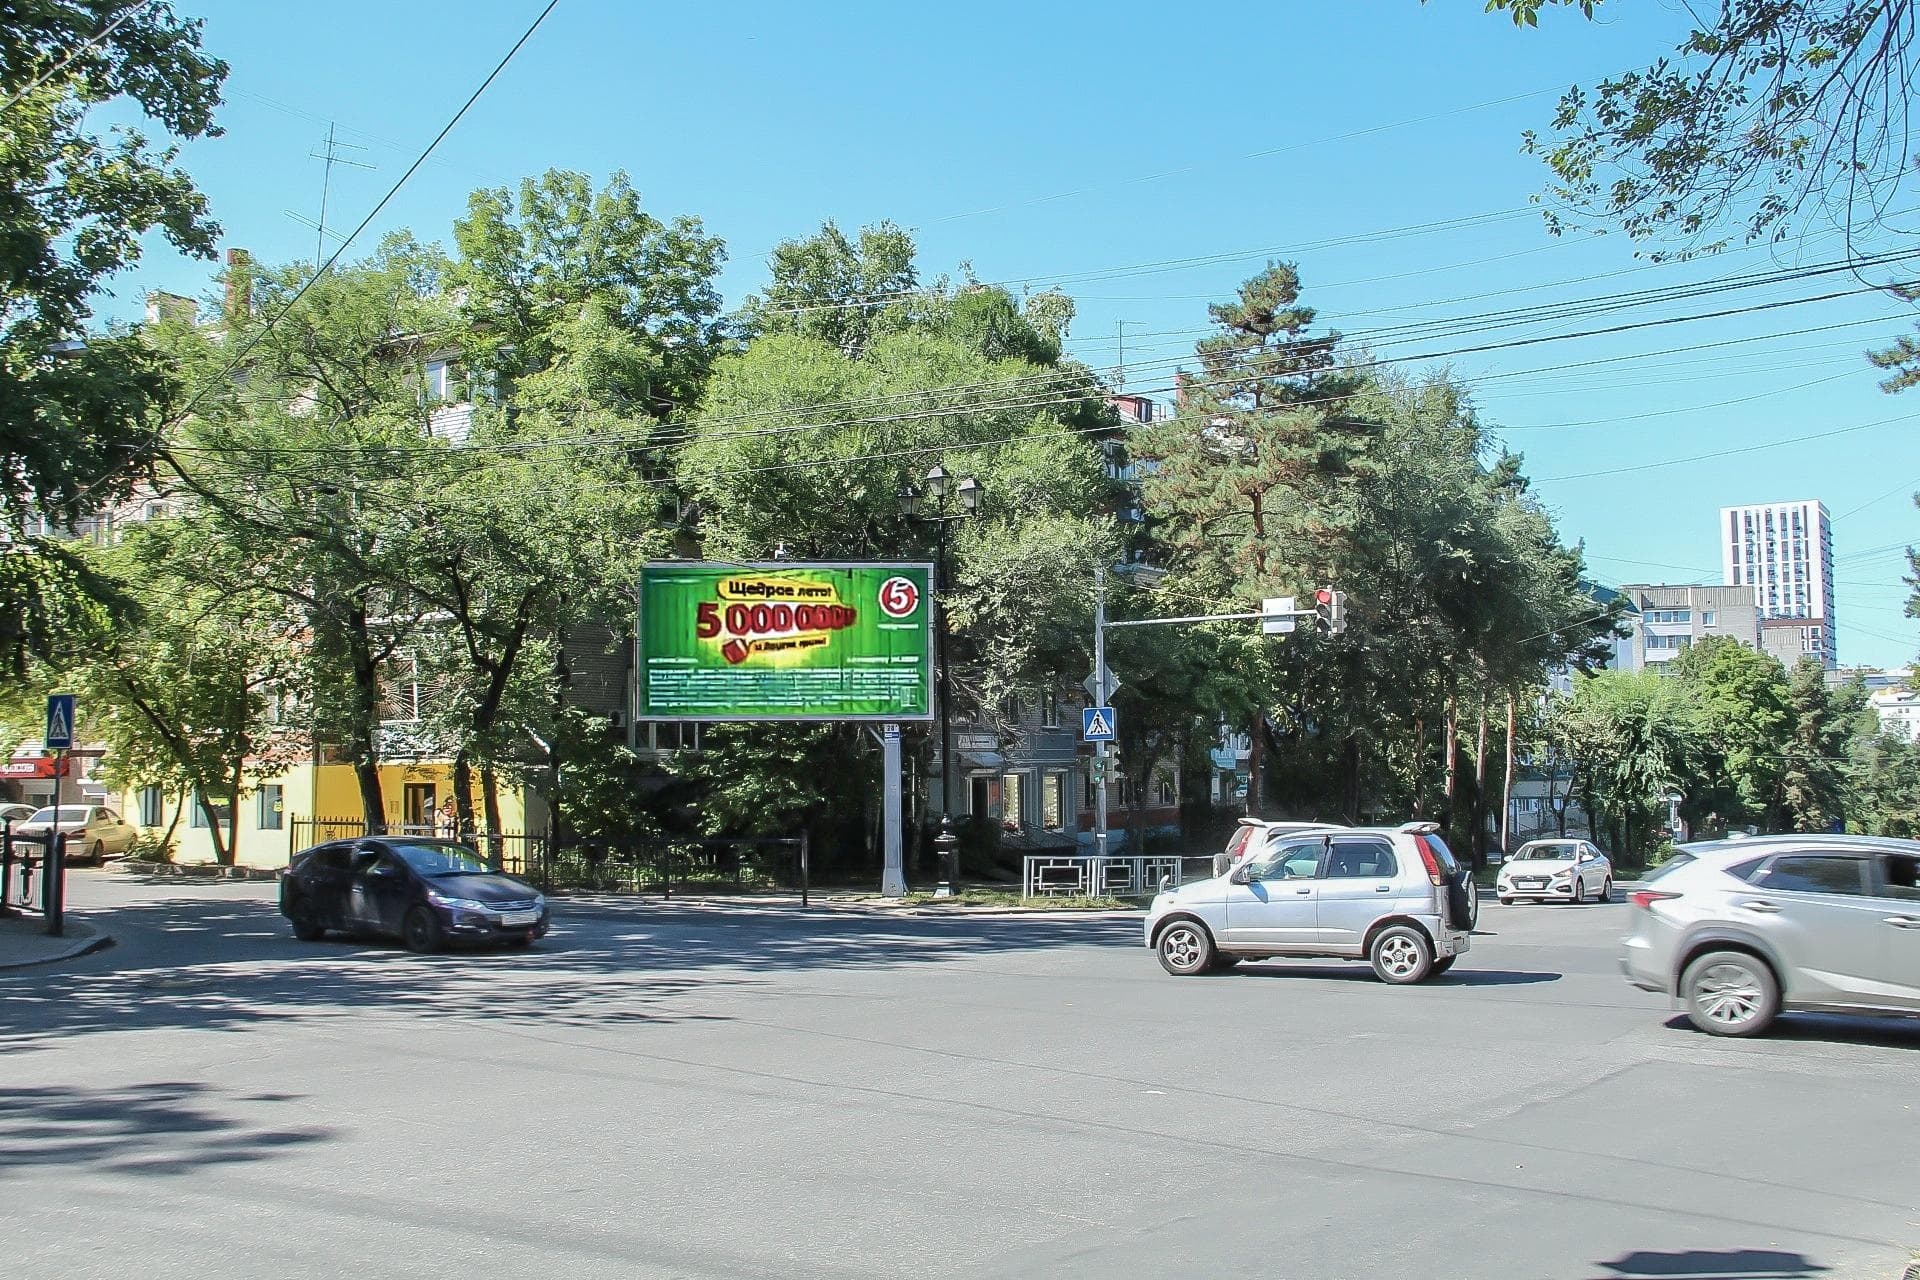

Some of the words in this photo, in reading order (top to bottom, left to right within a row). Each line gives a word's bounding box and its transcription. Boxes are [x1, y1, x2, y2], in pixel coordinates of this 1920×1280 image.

[729, 580, 793, 598] Щедрое
[797, 586, 832, 598] лето!
[697, 602, 721, 638] 5
[726, 603, 793, 635] 000
